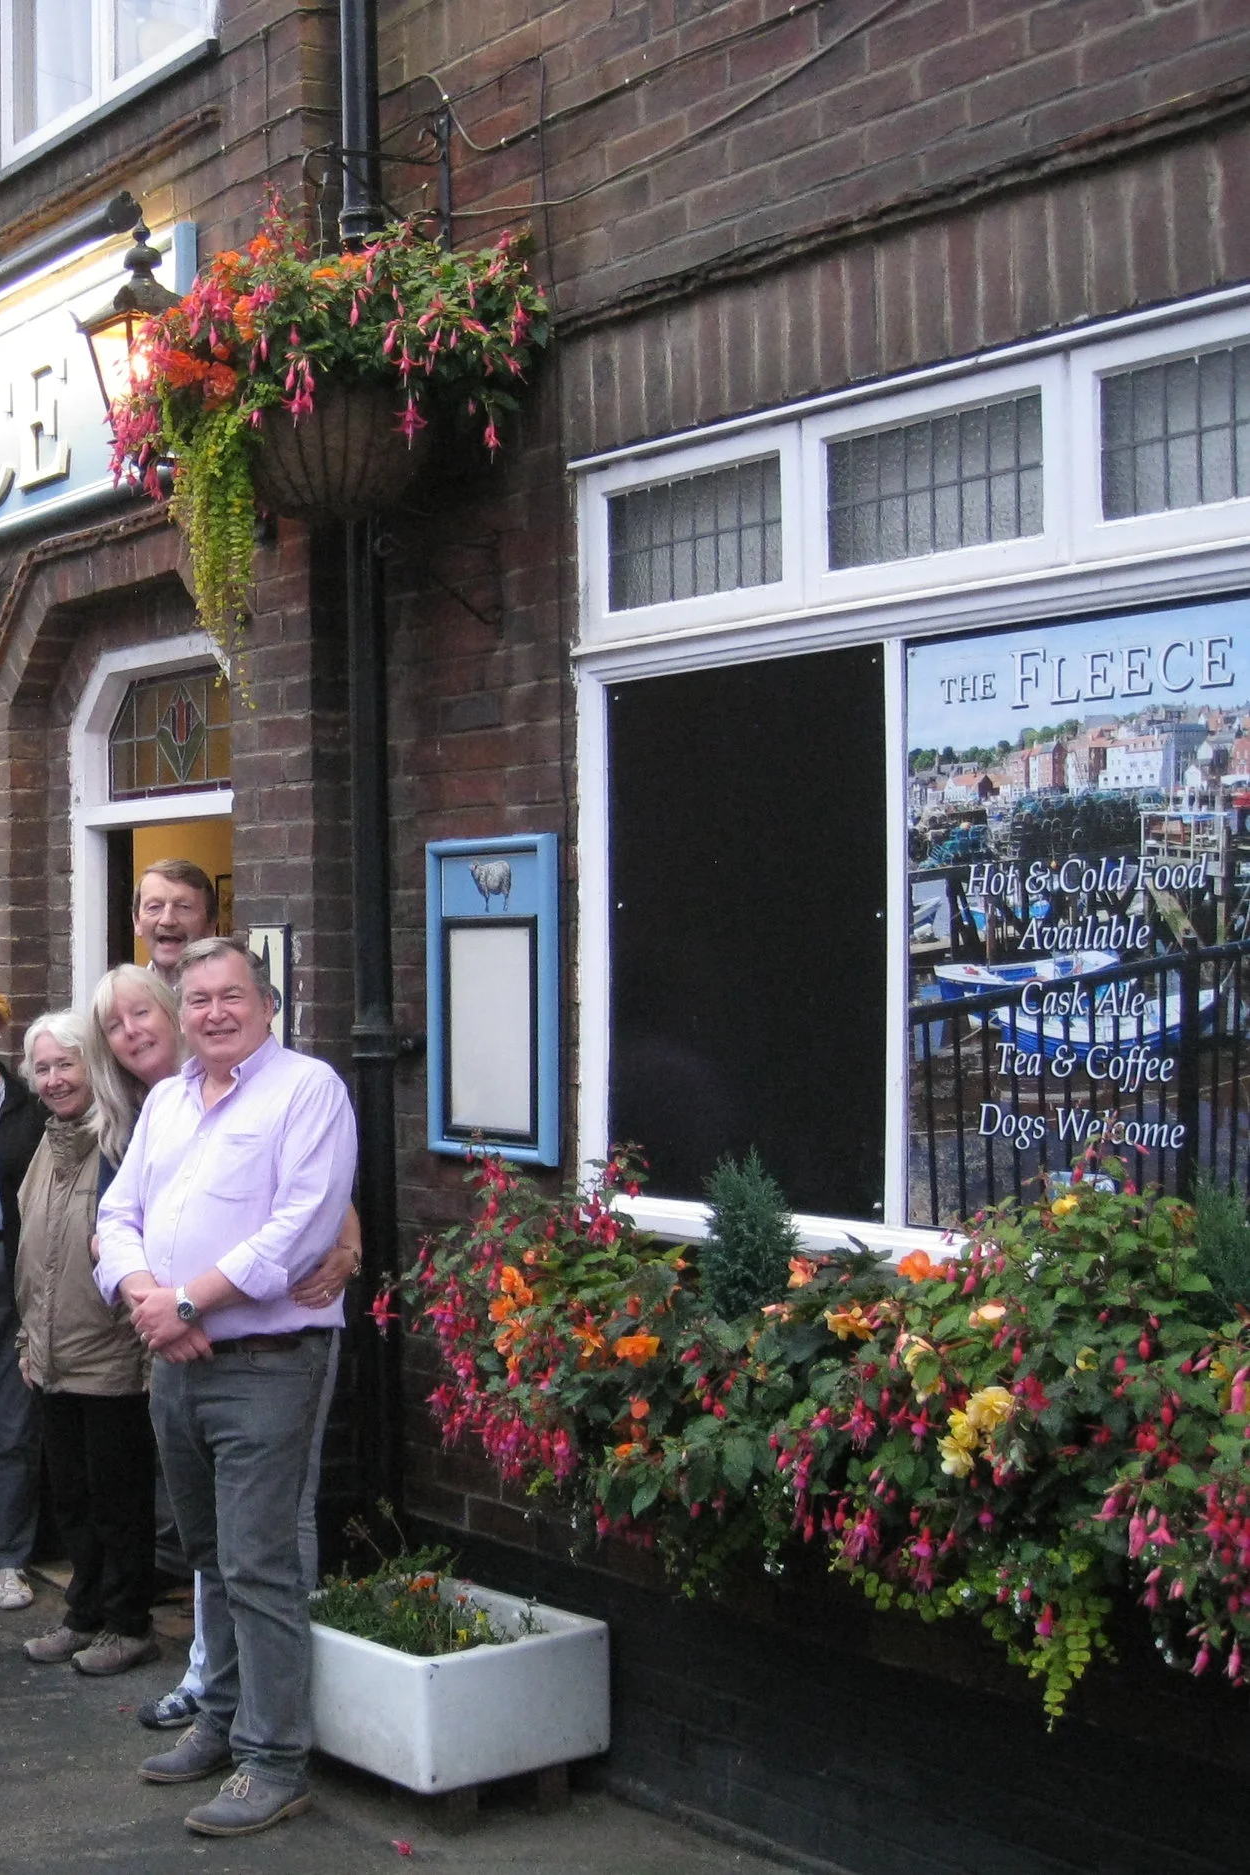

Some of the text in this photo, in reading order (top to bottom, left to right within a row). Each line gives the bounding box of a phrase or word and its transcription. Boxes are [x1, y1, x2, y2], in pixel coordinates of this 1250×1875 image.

[940, 635, 1235, 710] THE FLEECE
[966, 853, 1208, 896] Hot & Cold Food
[1017, 915, 1151, 950] Available
[1020, 980, 1147, 1017] Cask Ale
[995, 1042, 1175, 1093] Tea & Coffee
[978, 1102, 1186, 1150] Dogs Welcome
